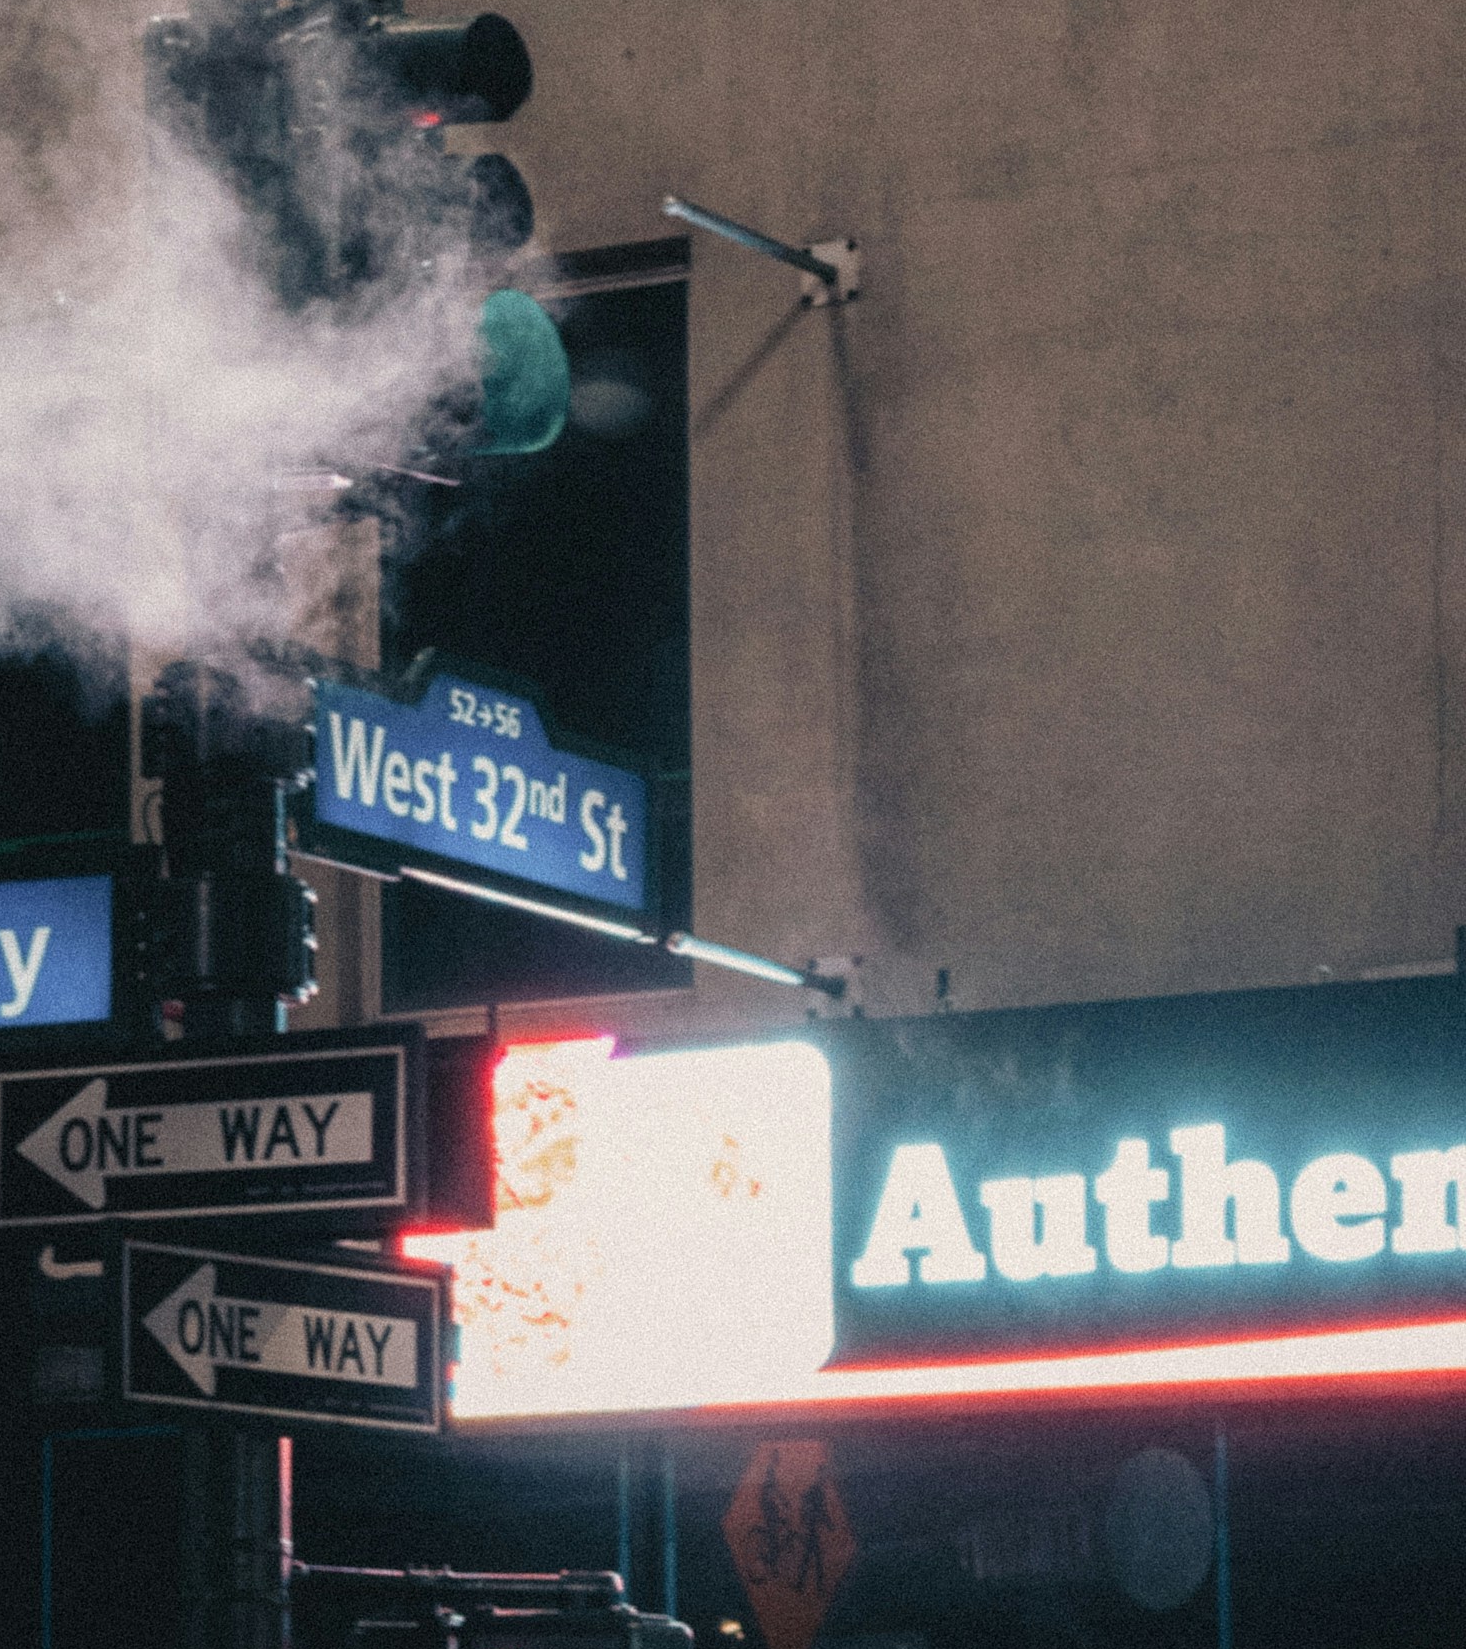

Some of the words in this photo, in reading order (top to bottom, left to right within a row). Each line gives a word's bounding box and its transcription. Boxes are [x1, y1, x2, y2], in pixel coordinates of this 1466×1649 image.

[449, 687, 477, 726] 52
[328, 710, 458, 832] West
[470, 755, 567, 852] 32nd
[579, 788, 628, 881] St
[59, 1113, 166, 1173] ONE
[218, 1102, 342, 1162] WAY
[176, 1298, 262, 1363] ONE
[303, 1313, 394, 1377] WAY
